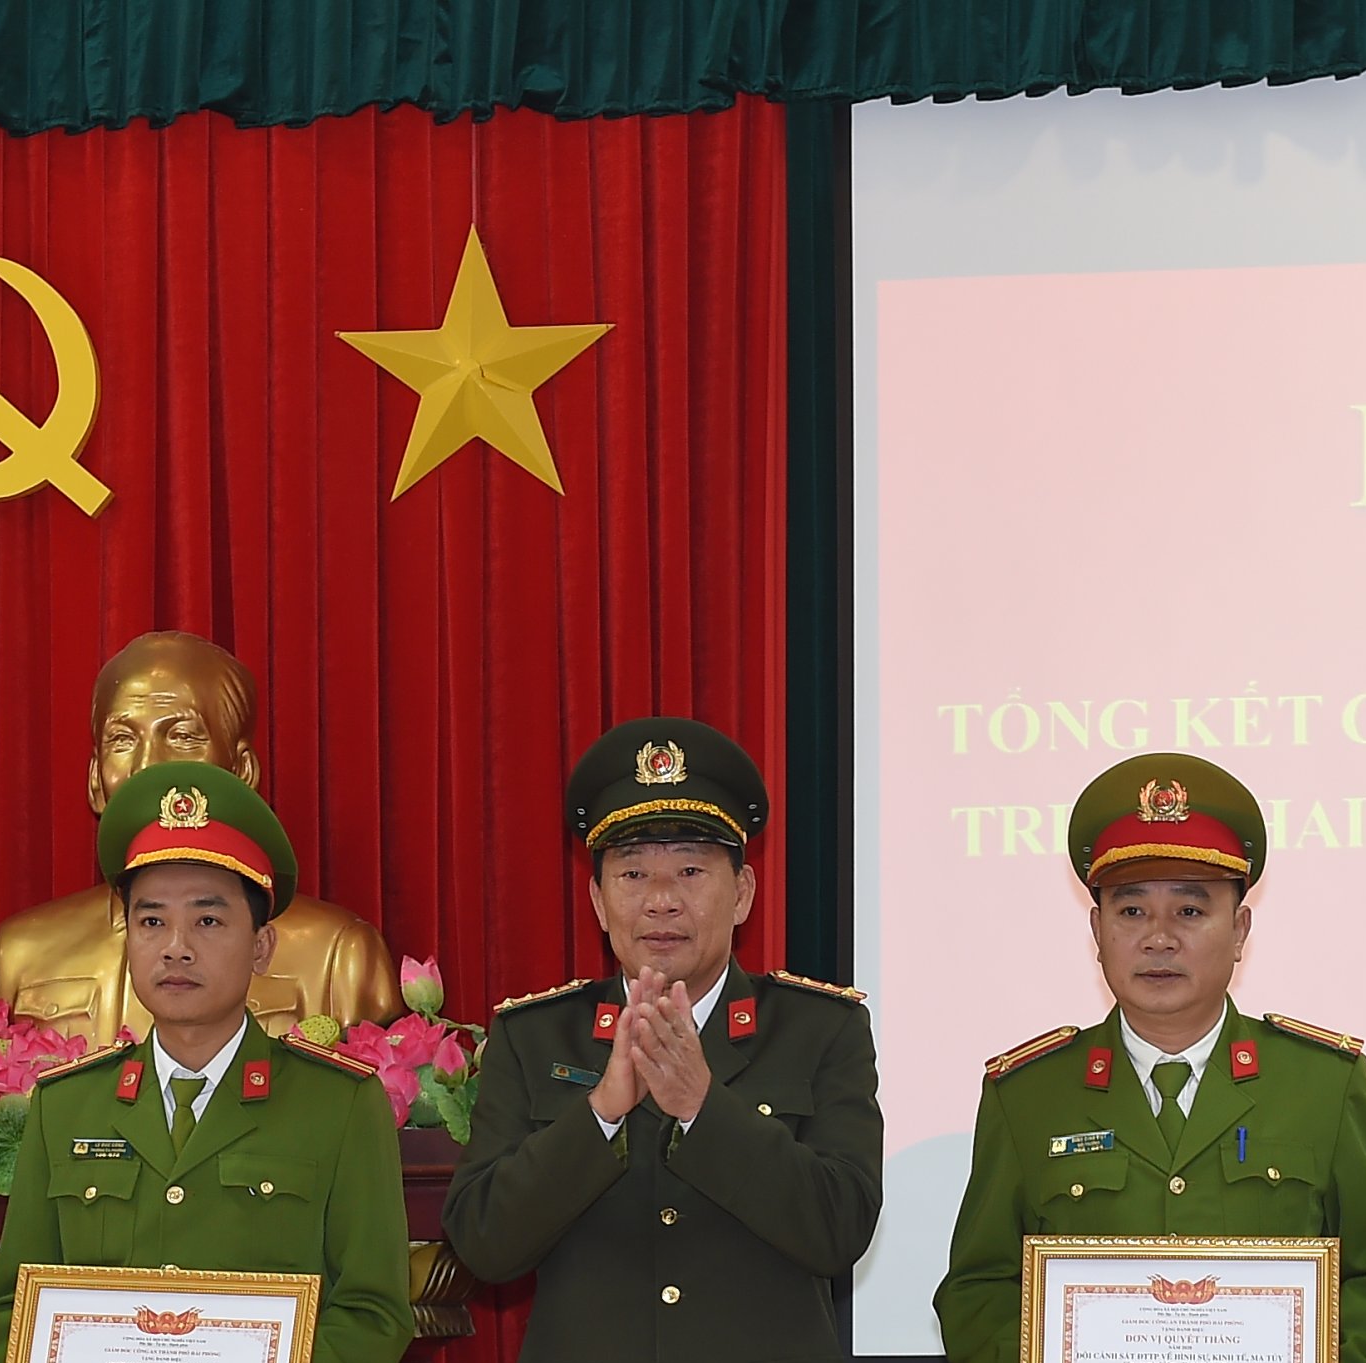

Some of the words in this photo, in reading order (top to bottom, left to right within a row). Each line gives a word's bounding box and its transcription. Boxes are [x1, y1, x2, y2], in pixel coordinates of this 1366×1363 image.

[938, 685, 1148, 755] TỔNG
[1171, 678, 1324, 749] KẾT
[951, 803, 1068, 857] TRI
[1261, 797, 1366, 849] HAI
